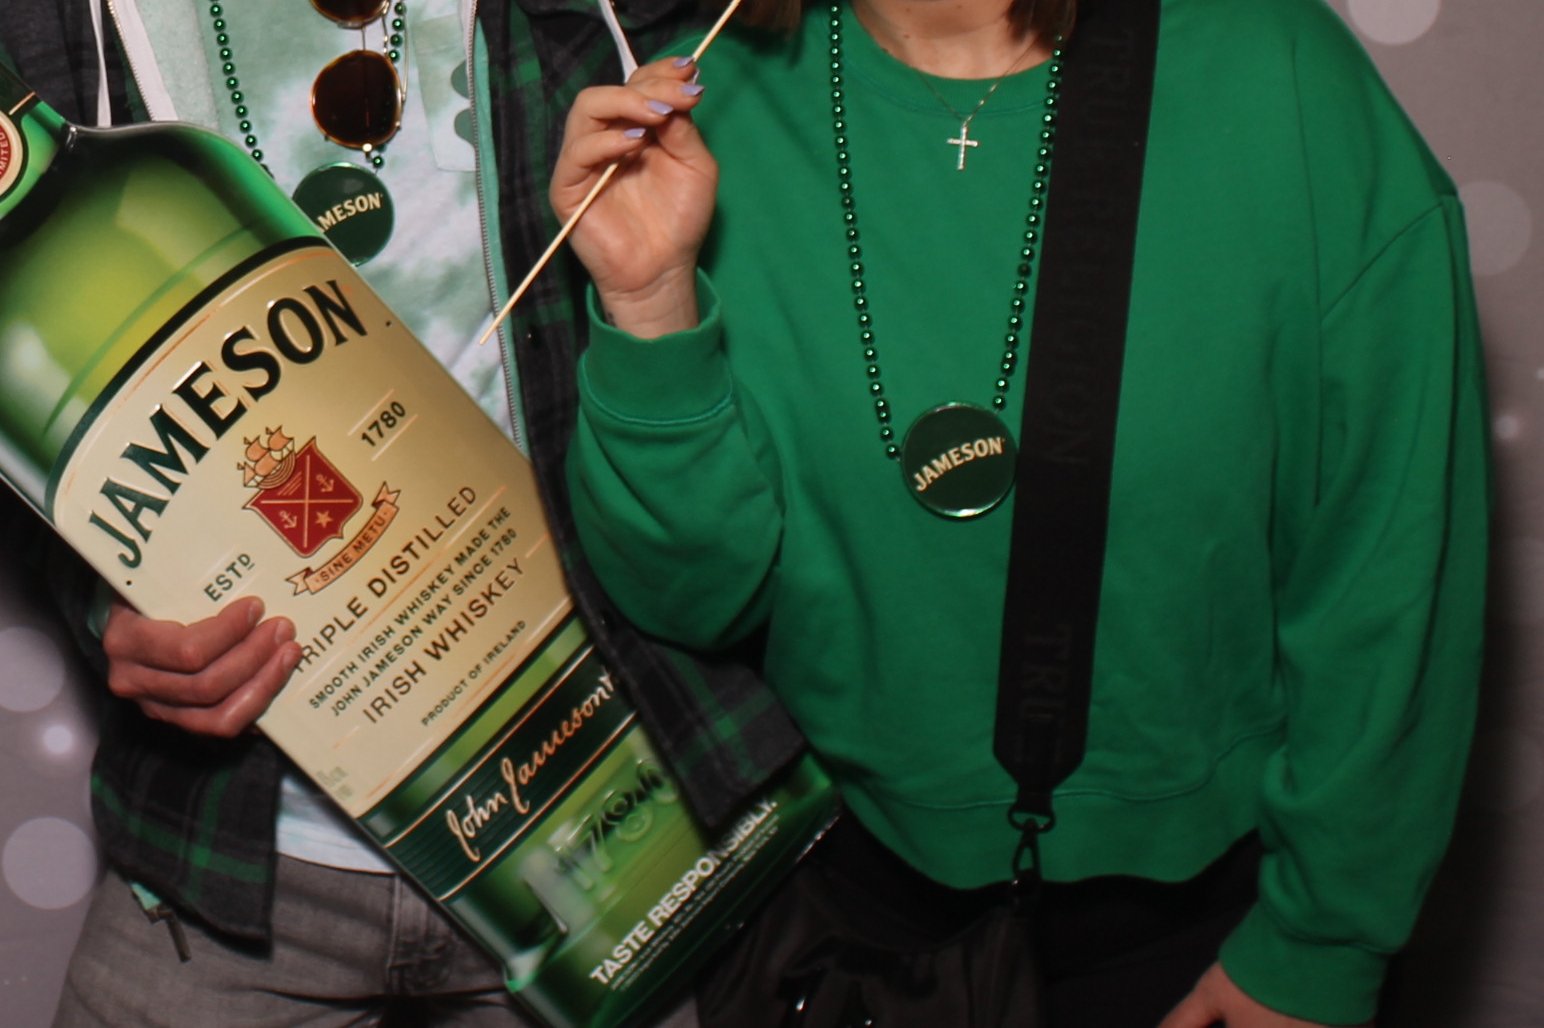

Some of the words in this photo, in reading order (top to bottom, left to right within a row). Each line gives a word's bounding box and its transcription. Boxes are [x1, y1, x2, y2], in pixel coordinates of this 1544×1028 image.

[317, 192, 381, 234] MESON
[89, 279, 368, 570] JAMESON
[361, 401, 406, 447] 1780
[914, 436, 1004, 491] JAMESON
[319, 553, 353, 582] SINE
[353, 515, 387, 553] METU
[367, 486, 477, 599] DISTILLED
[204, 553, 255, 602] ESTD
[309, 661, 359, 709] SMOOTH
[356, 625, 395, 663] IRISH
[394, 565, 456, 626] WHISKEY
[454, 528, 490, 565] MADE
[487, 506, 511, 531] THE
[331, 684, 363, 717] JOHN
[362, 625, 423, 687] JAMESON
[422, 593, 453, 626] WAY
[453, 558, 493, 596] SINCE
[490, 527, 517, 556] 1780
[362, 660, 428, 724] IRISH
[423, 557, 524, 662] WHISKEY
[421, 678, 470, 727] PRODUCT
[469, 664, 483, 680] OF
[483, 620, 526, 665] IRELAND
[446, 793, 508, 862] John
[589, 921, 655, 984] TASTE
